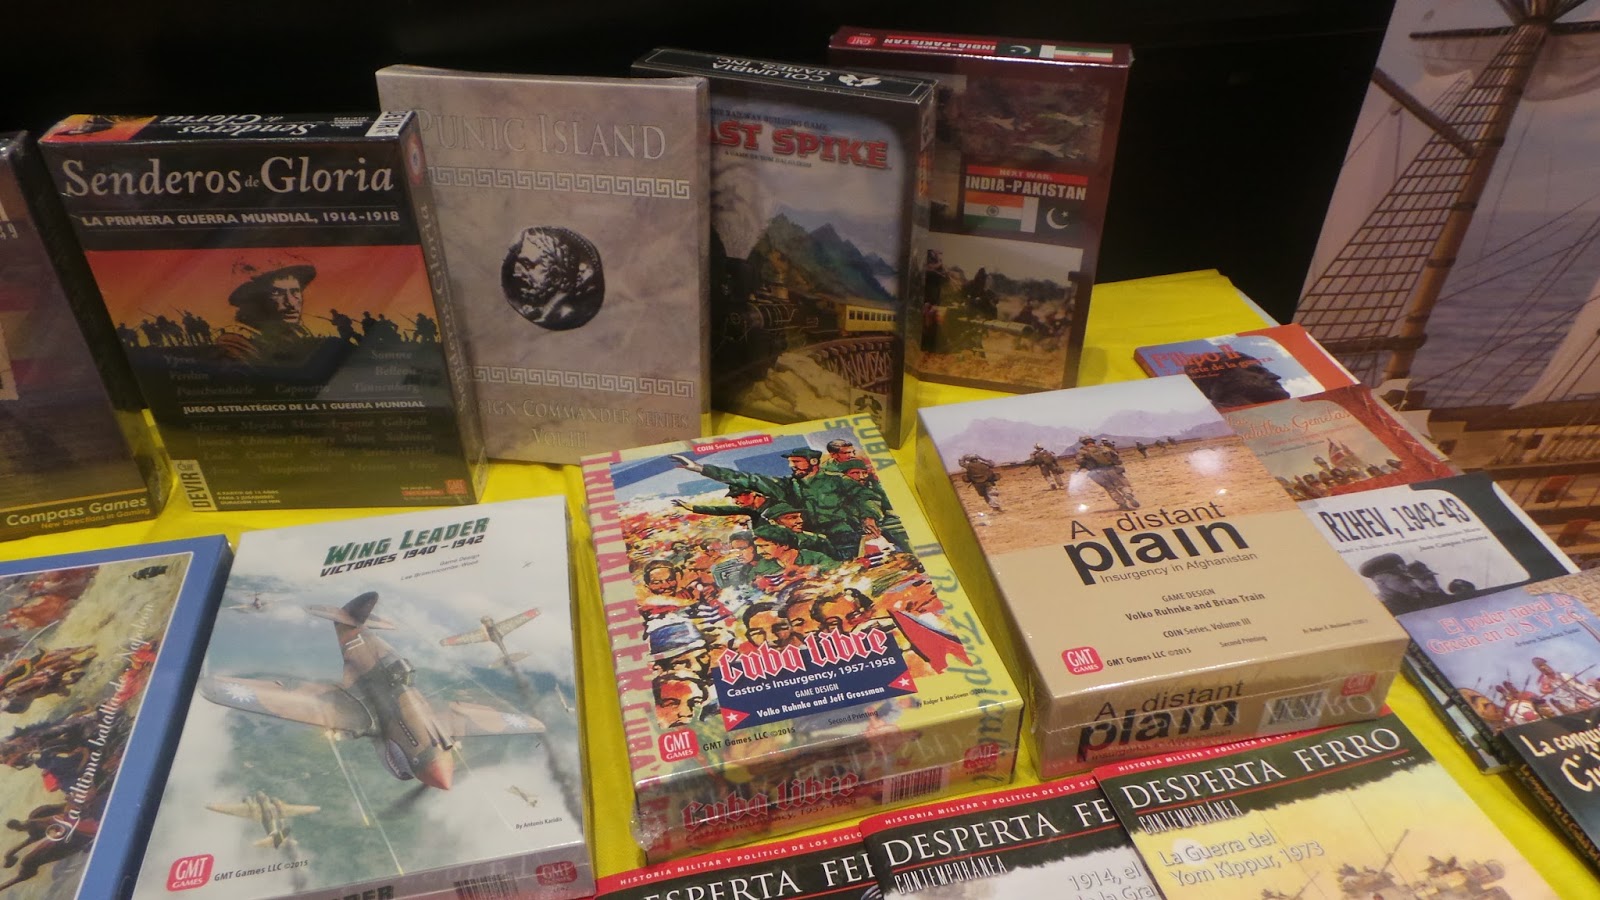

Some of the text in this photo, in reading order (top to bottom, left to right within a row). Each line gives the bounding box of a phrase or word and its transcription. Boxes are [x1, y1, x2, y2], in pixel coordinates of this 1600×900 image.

[884, 37, 997, 51] INDIA-PAKISTAN
[712, 62, 825, 82] COLUMBIA
[160, 114, 261, 125] Gloria
[177, 123, 317, 136] Senderos
[417, 109, 666, 160] PUNIC ISLAND
[772, 127, 888, 169] SPIKE
[62, 156, 394, 198] Senderos de Gloria
[999, 169, 1023, 177] NEXT
[965, 176, 1087, 201] INDIA-PAKISTAN
[82, 210, 400, 227] LA PRIMERA GUERRA MUNDIAL, 1914-1918
[1211, 361, 1237, 371] de la
[182, 400, 426, 415] JUEGO ESTRATÉGICO DE LA GUERRA MUNDIAL
[522, 399, 689, 429] COMMANDER SERIES
[1291, 406, 1351, 434] Gemelas
[697, 444, 714, 452] COIN
[715, 442, 737, 451] Series,
[737, 438, 763, 446] Volume
[180, 472, 212, 508] DEVIR
[6, 497, 147, 526] Compass Games
[41, 508, 150, 529] New Directions in Gaming
[1071, 500, 1226, 540] A distant
[1317, 497, 1472, 543] RZHEV, 1942-43
[319, 553, 398, 578] VICTORIES
[403, 544, 438, 560] 1940
[452, 534, 485, 549] 1942
[323, 516, 491, 567] WING LEADER
[1063, 521, 1250, 586] plain
[1099, 552, 1259, 584] Insurgency in Afghanistan
[1125, 592, 1266, 621] Volko Ruhnke and Brian Train
[1161, 588, 1216, 603] GAME DESIGN
[1162, 617, 1252, 639] COIN Series, Volume III
[1439, 593, 1574, 635] El poder naval de
[1219, 634, 1268, 648] Second Printing
[1426, 633, 1482, 655] Grecia
[1482, 628, 1504, 643] en
[1504, 622, 1521, 638] el
[1534, 612, 1554, 629] V
[717, 627, 888, 685] Cuba libre
[1067, 649, 1095, 667] GMT
[1073, 663, 1099, 674] GAMES
[1106, 657, 1124, 667] GMT
[1126, 654, 1151, 664] Games
[1152, 650, 1166, 660] LLC
[726, 656, 896, 698] Castro's Insurgency, 1957-1958
[794, 683, 839, 698] GAME DESIGN
[757, 686, 885, 718] Volko Ruhnke and Jeff Grossman
[1094, 679, 1244, 722] A distant
[828, 710, 878, 726] Second Printing
[1076, 700, 1240, 763] plain
[662, 732, 690, 752] GMT
[666, 748, 693, 760] GAMES
[703, 740, 722, 752] GMT
[724, 734, 753, 748] Games
[754, 731, 769, 740] LLC
[1118, 736, 1275, 772] HISTORIA MILITAR Y POLÍTICA DE
[1519, 734, 1557, 758] La
[1119, 727, 1401, 810] DESPERTA FERRO
[680, 791, 768, 832] Cuba
[776, 772, 859, 811] libre
[884, 810, 934, 826] HISTORIA
[938, 801, 979, 815] MILITAR
[992, 791, 1038, 805] POLÍTICA
[1042, 788, 1055, 796] DE
[1057, 783, 1075, 793] LOS
[1137, 799, 1244, 835] CONTEMPORÁNEA
[881, 811, 1062, 868] DESPERTA
[1158, 828, 1277, 867] La Guerra del
[175, 856, 208, 881] GMT
[214, 871, 233, 882] GMT
[236, 867, 265, 878] Games
[268, 862, 282, 872] LLC
[620, 838, 828, 886] HISTORIA MILITAR Y POLÍTICA DE LOS
[893, 854, 1008, 896] CONTEMPORÁNEA
[1067, 861, 1142, 892] 1914, el
[1169, 839, 1326, 887] Yom Kippur, 1973
[172, 877, 204, 889] GAMES
